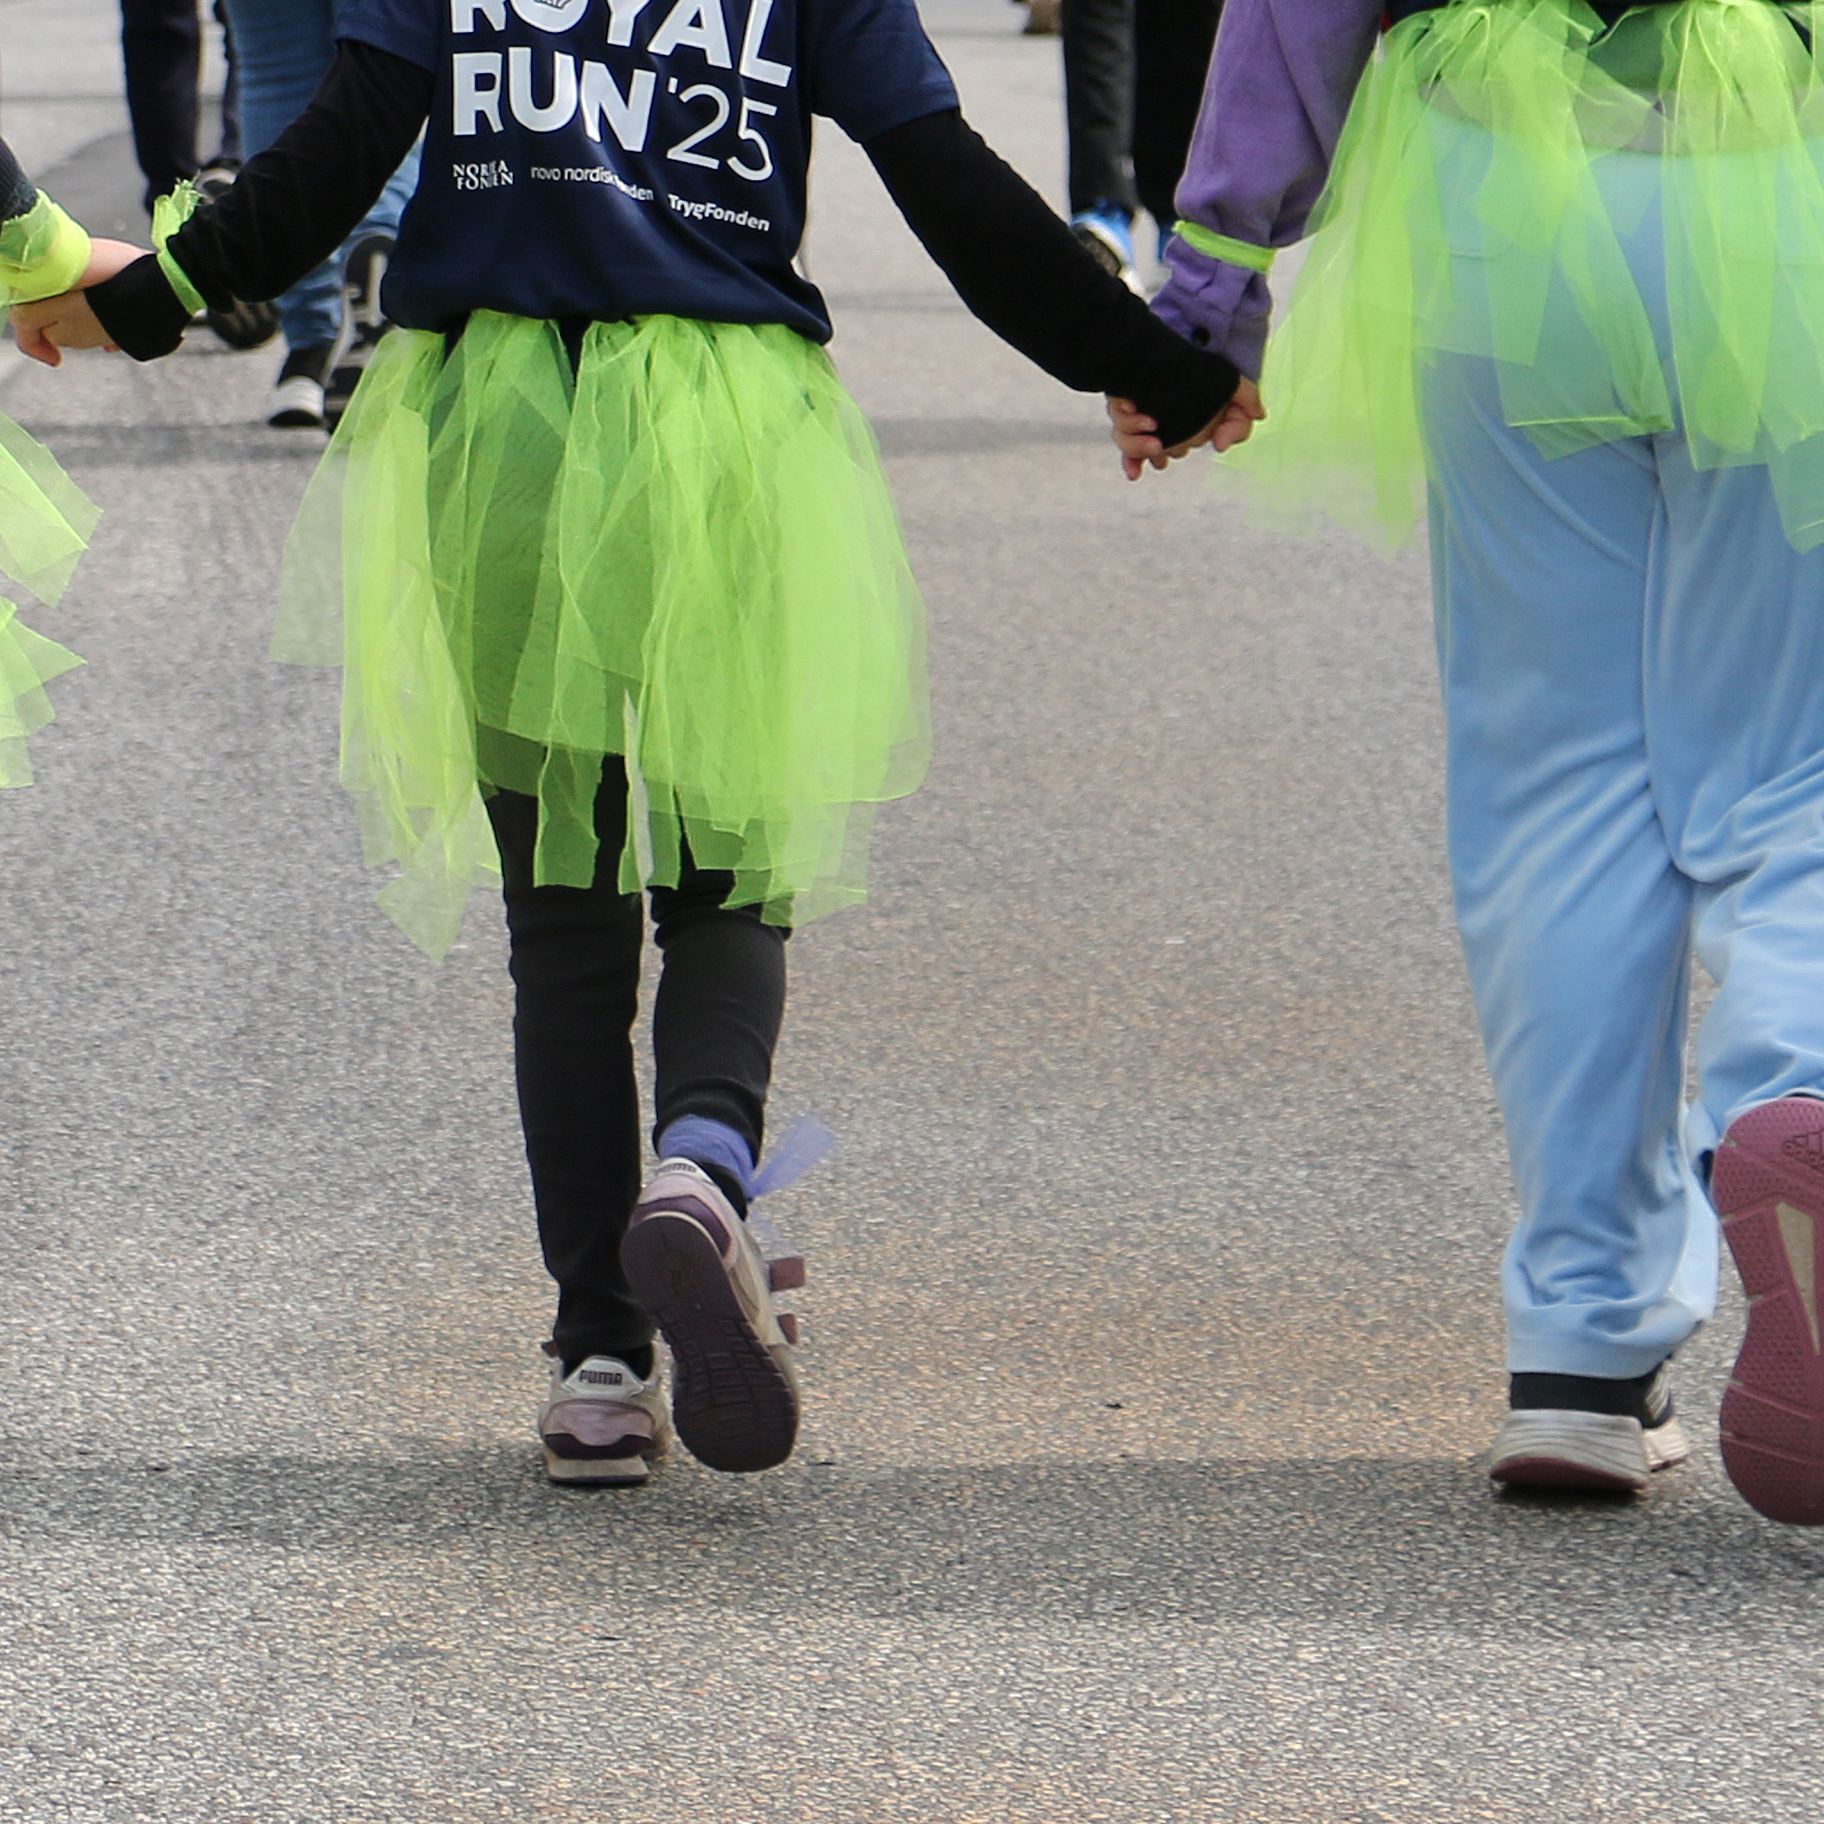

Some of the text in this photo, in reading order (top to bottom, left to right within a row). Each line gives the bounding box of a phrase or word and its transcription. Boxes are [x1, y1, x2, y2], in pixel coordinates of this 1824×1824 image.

[530, 165, 561, 181] novo
[667, 193, 771, 232] TrygFonden
[579, 1370, 622, 1386] PUMA
